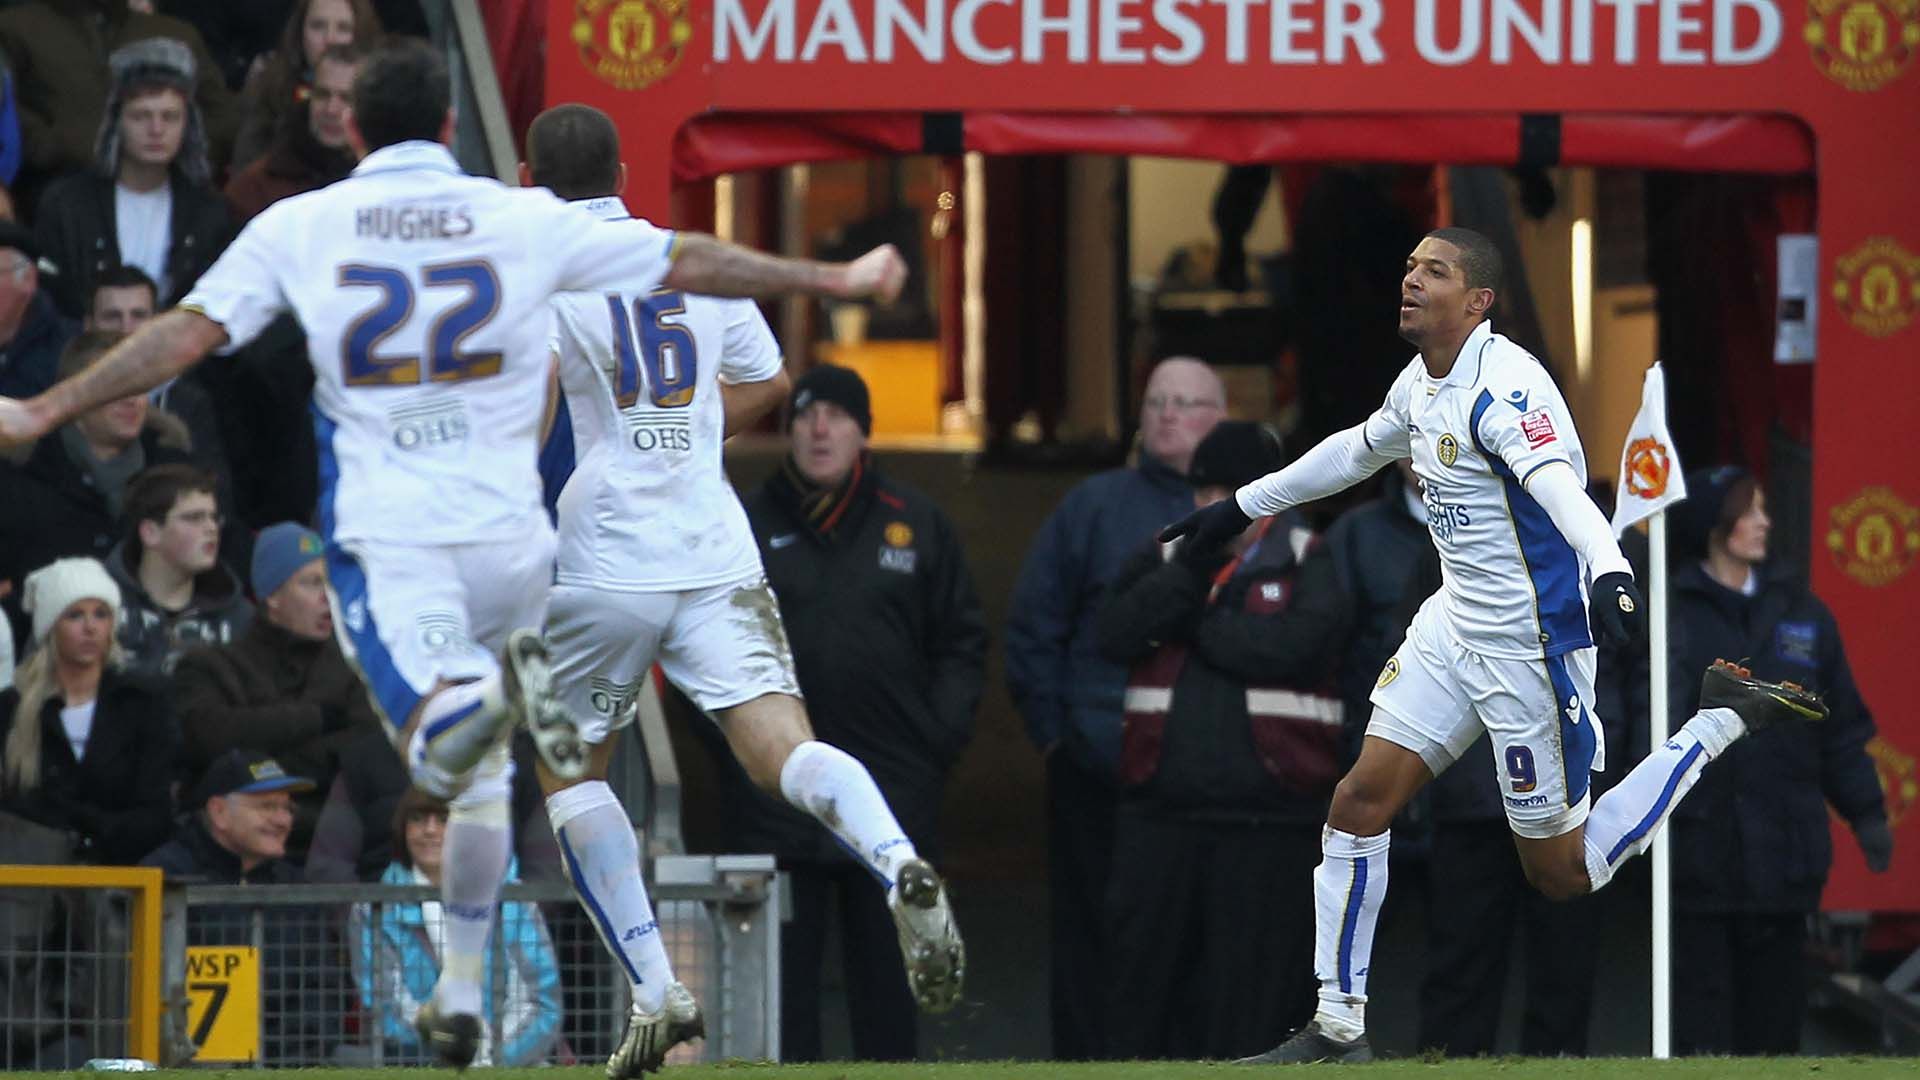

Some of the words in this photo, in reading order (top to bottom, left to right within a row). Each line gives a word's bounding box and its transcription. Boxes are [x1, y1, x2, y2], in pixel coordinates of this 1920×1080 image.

[712, 0, 1385, 63] MANCHESTER
[1413, 0, 1782, 65] UNITED
[355, 206, 474, 241] HUGHES
[337, 257, 504, 388] 22
[607, 289, 698, 410] 16
[393, 418, 469, 451] OHS
[633, 426, 691, 452] OHS
[1426, 504, 1471, 528] GHTS
[1504, 745, 1537, 793] 9
[186, 953, 240, 978] WSP
[190, 983, 230, 1047] 7
